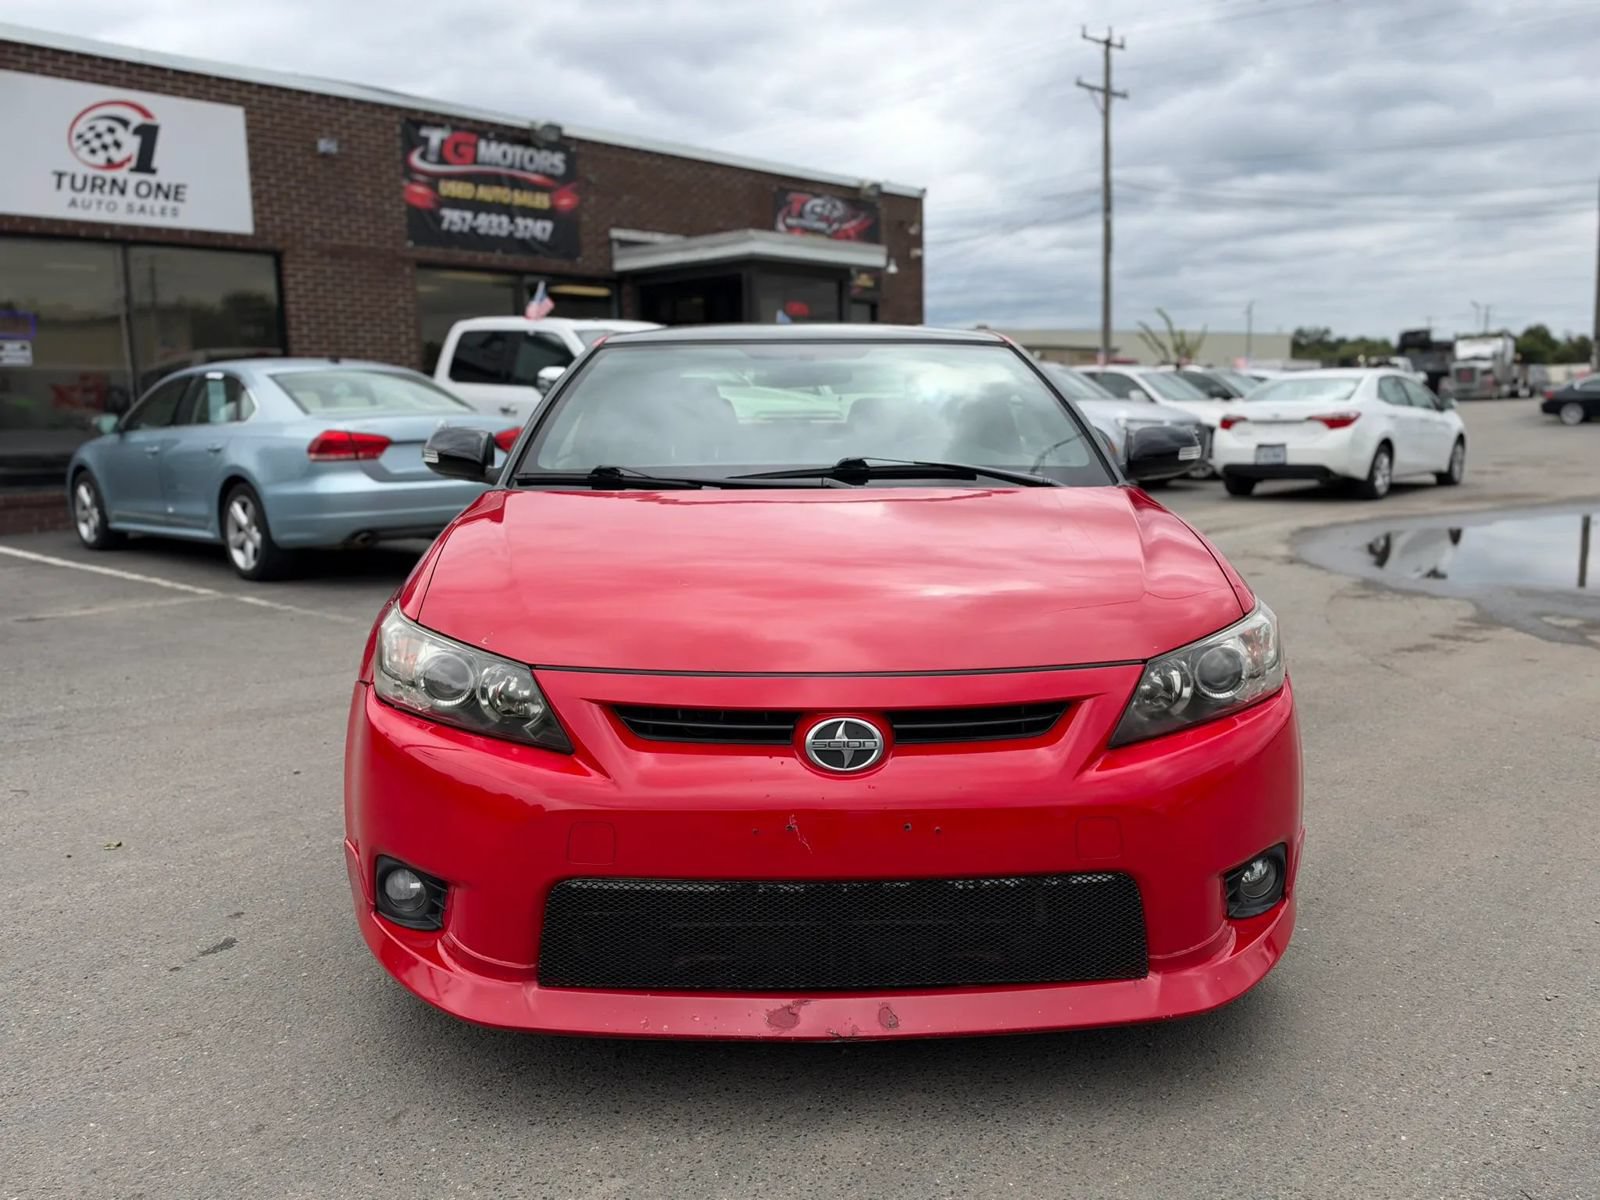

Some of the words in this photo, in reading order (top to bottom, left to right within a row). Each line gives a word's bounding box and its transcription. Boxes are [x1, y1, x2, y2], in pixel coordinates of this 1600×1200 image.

[419, 126, 479, 165] TG
[478, 139, 566, 175] MOTORS
[52, 171, 127, 196] TURN
[134, 180, 188, 202] ONE
[440, 180, 475, 198] USED
[476, 185, 512, 203] AUTO
[512, 189, 550, 209] SALES
[67, 198, 118, 212] AUTO
[125, 203, 180, 218] SALES
[812, 740, 878, 749] SCION
